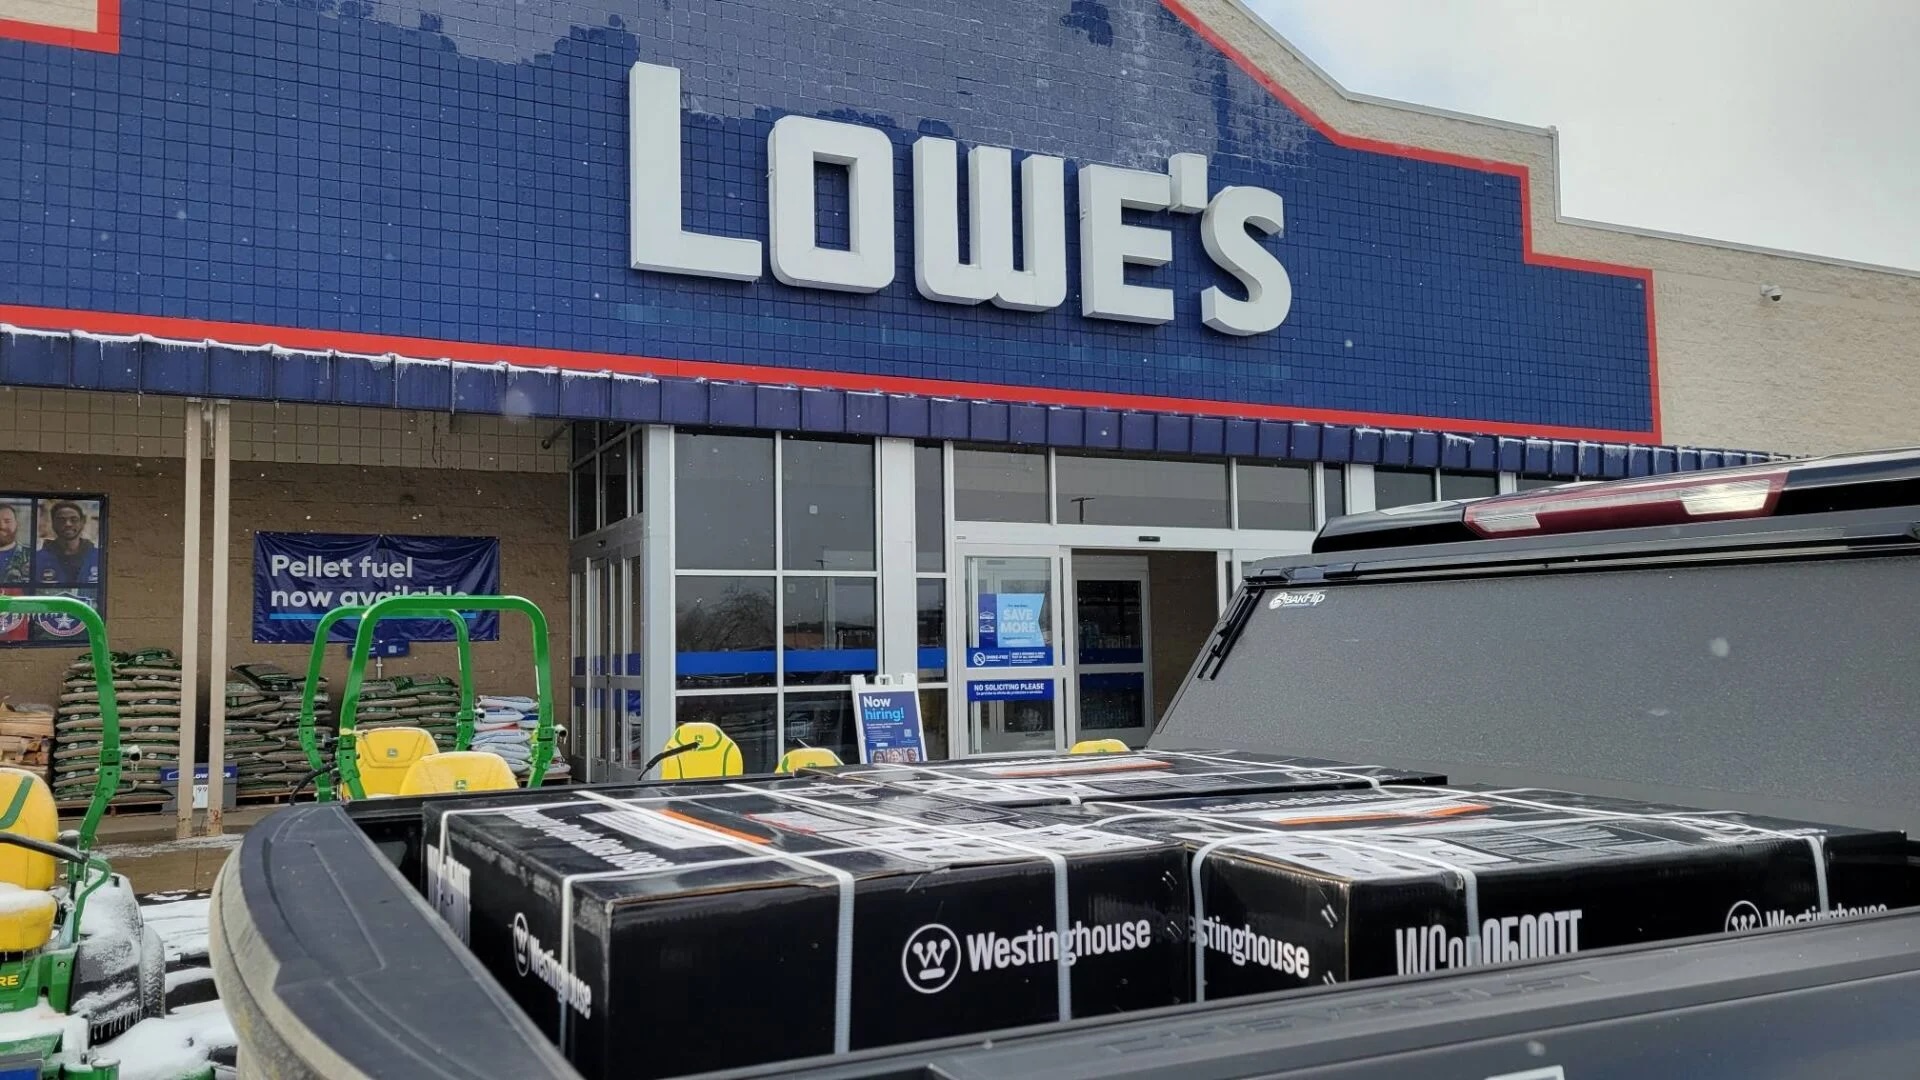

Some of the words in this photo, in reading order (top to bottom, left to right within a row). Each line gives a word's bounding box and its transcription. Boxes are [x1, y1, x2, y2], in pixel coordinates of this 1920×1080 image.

[629, 61, 1292, 336] LOWE'S
[271, 555, 352, 577] Pellet
[359, 555, 413, 578] fuel
[271, 590, 333, 607] now
[1003, 608, 1033, 620] SAVE
[1001, 621, 1036, 633] MORE
[984, 683, 1019, 691] SOLICITING
[1020, 682, 1045, 690] PLEASE
[863, 695, 891, 708] Now
[864, 706, 905, 722] hiring!
[966, 919, 1151, 973] Westinghouse
[1188, 915, 1311, 979] estinghouse
